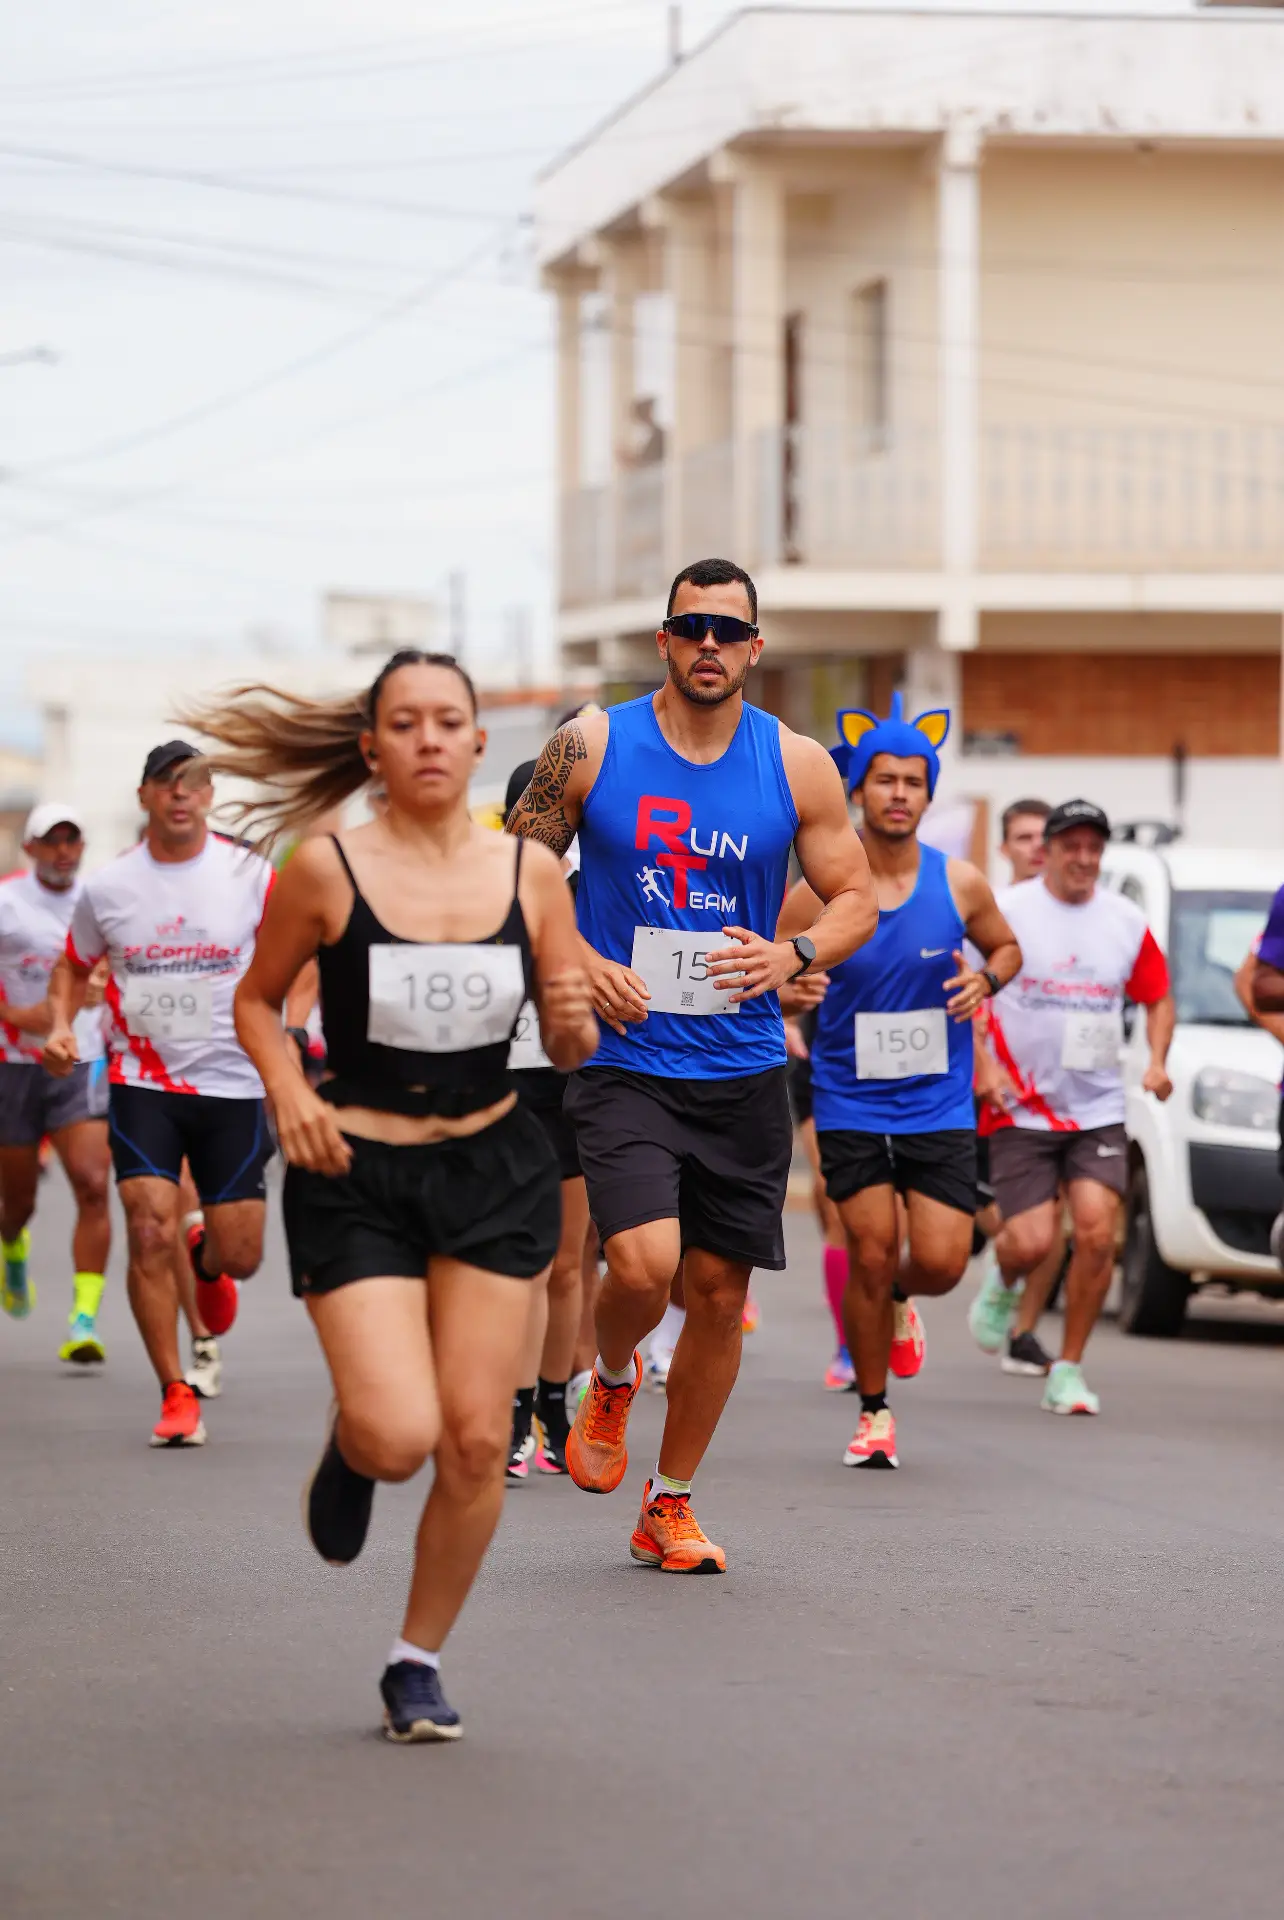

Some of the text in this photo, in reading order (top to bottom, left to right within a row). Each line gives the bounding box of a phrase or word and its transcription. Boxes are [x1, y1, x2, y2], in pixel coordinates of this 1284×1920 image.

[635, 794, 748, 861] RUN
[655, 853, 737, 912] TEAM
[140, 993, 197, 1016] 299
[401, 972, 493, 1012] 189
[874, 1027, 930, 1054] 150
